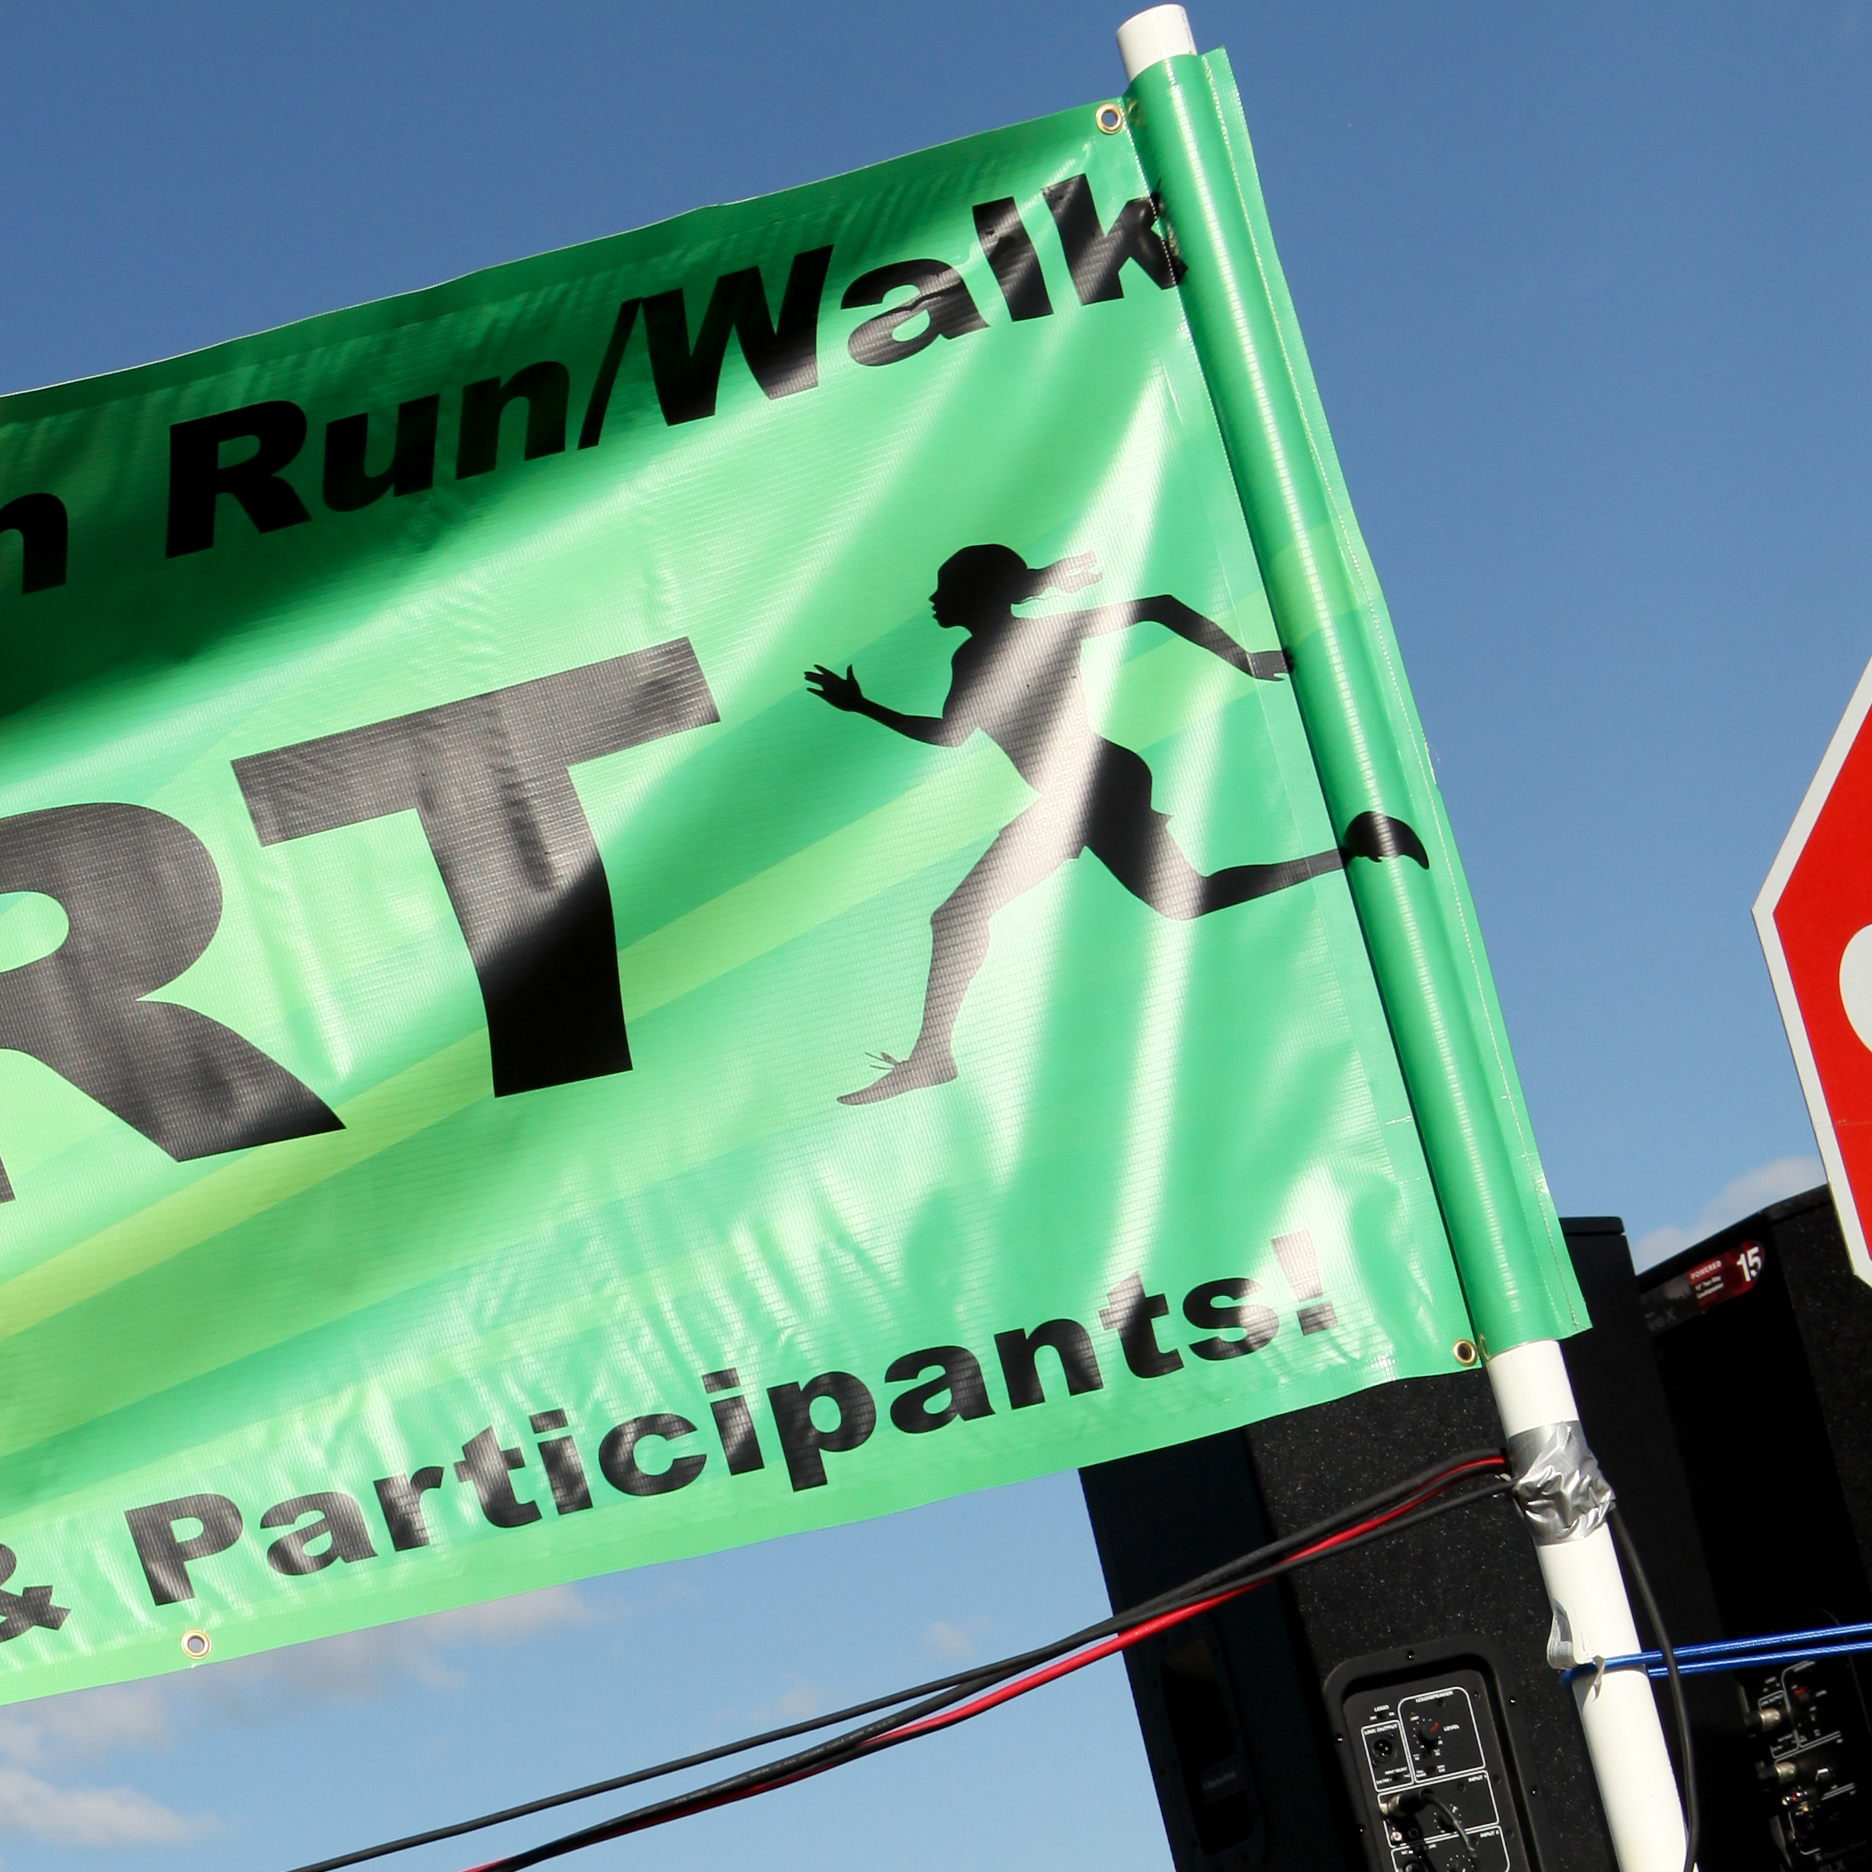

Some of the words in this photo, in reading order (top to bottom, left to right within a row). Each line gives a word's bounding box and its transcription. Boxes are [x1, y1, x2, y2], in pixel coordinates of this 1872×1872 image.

[162, 173, 1190, 561] Run/Walk
[125, 1231, 1338, 1606] Participants!
[1736, 1246, 1762, 1282] 15
